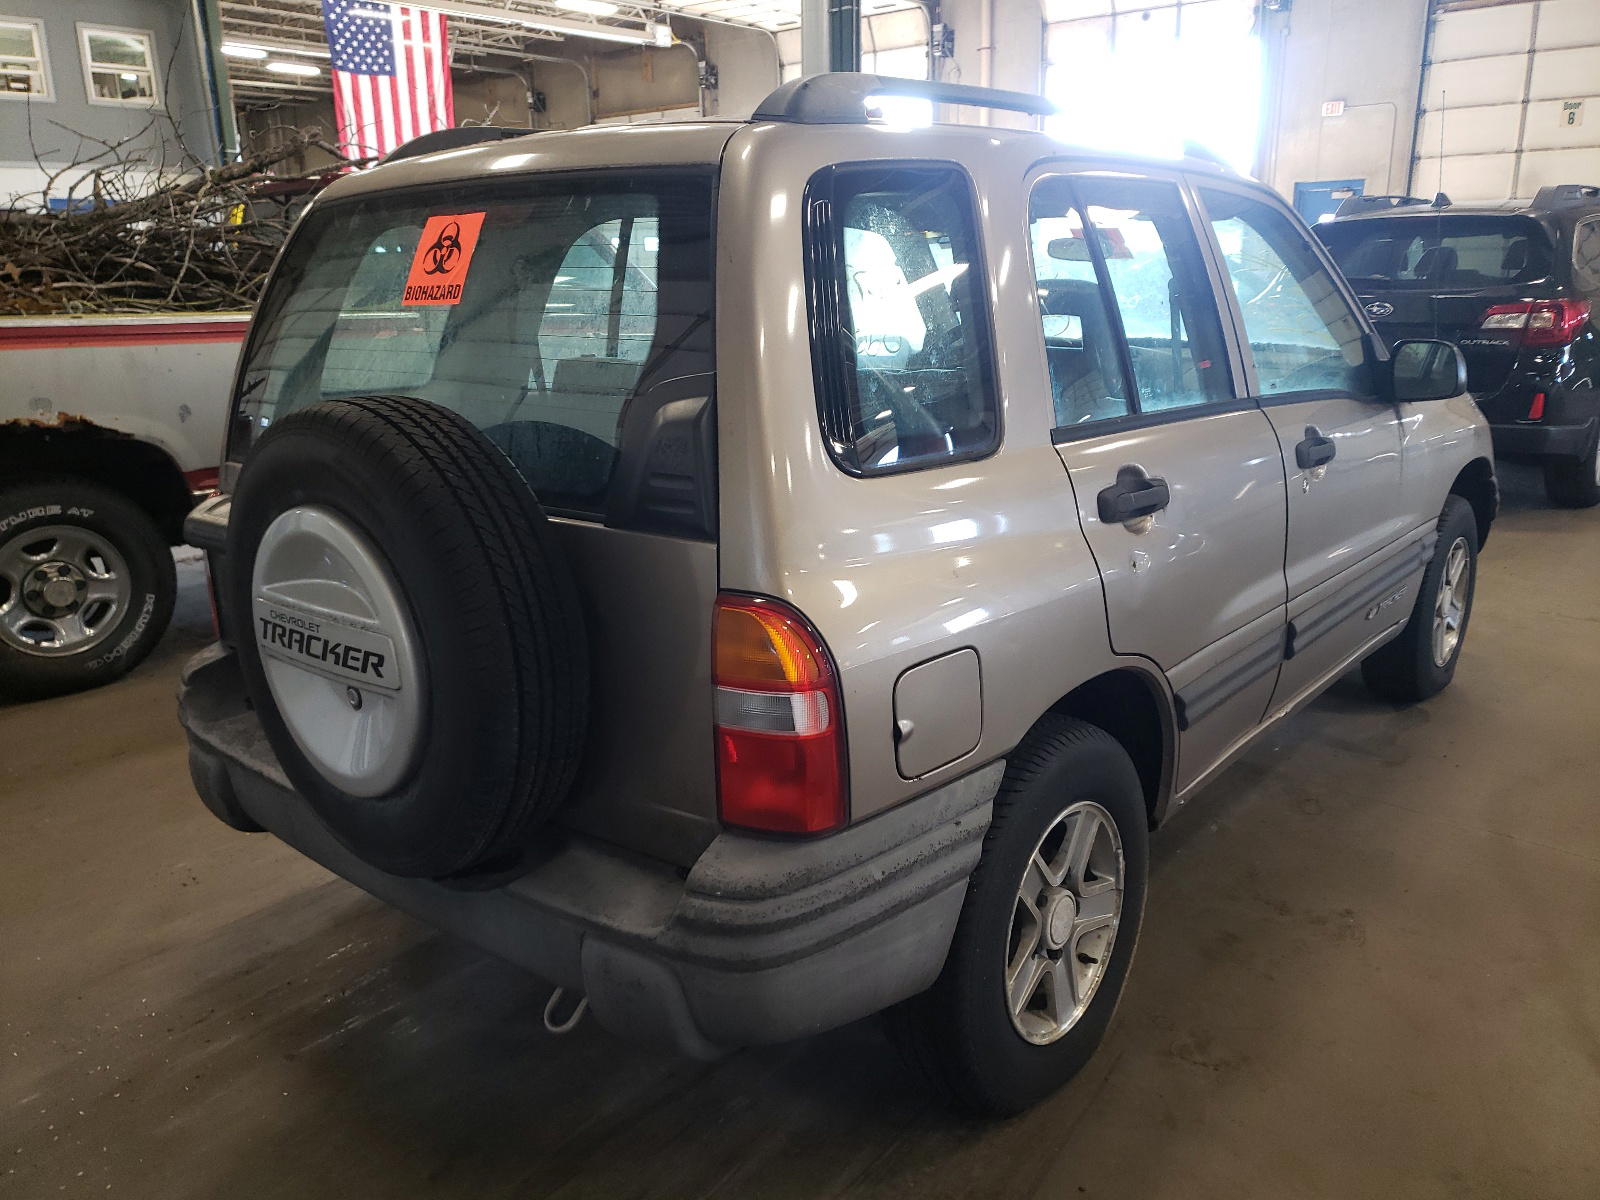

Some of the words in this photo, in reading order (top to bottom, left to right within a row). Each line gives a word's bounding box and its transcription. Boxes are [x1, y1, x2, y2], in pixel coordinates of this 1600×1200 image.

[404, 283, 462, 301] BIOHAZARD
[269, 609, 321, 633] CHEVROLET
[259, 616, 385, 679] TRACKER
